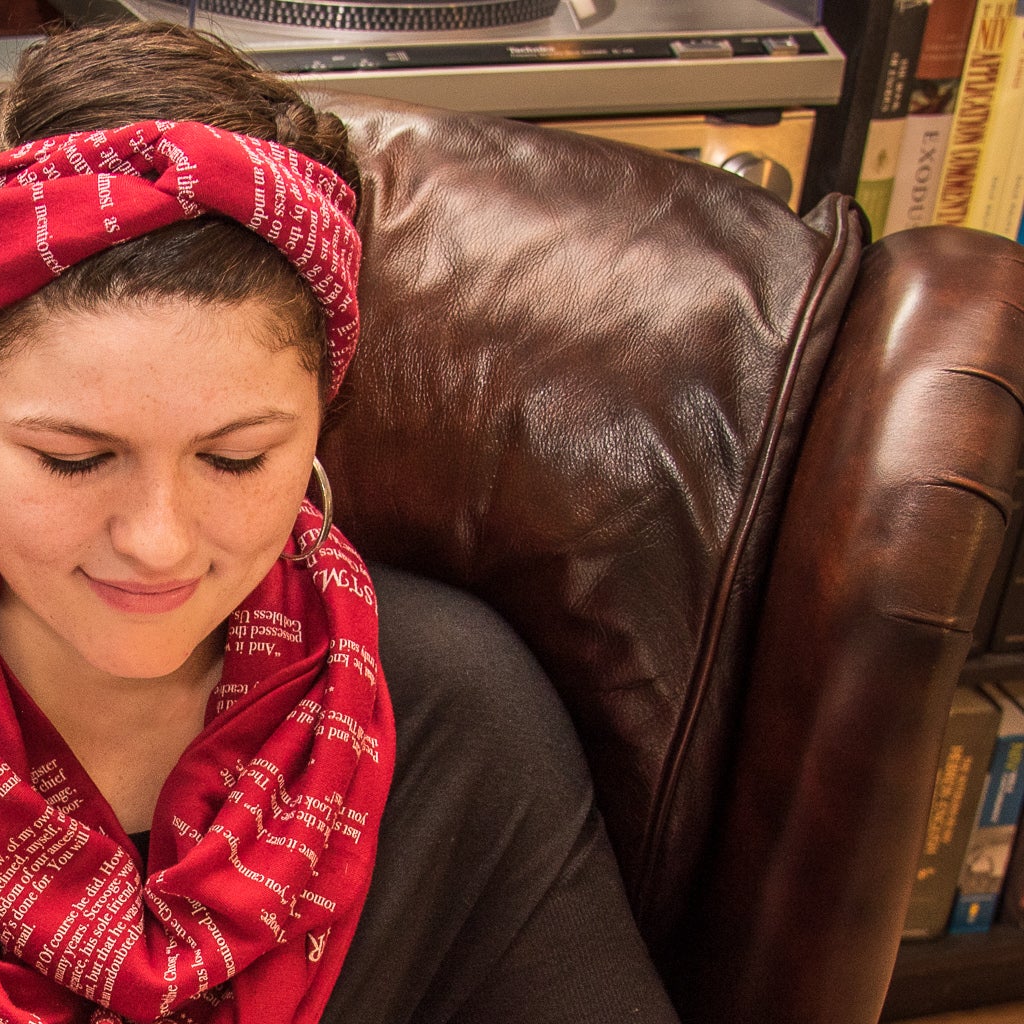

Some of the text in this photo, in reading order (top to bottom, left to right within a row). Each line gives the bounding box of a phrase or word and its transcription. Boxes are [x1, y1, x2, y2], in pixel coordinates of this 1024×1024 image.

[7, 838, 19, 852] of
[18, 826, 36, 842] my
[21, 866, 34, 884] of
[31, 852, 50, 872] our
[13, 891, 39, 921] done
[51, 911, 79, 948] course
[76, 896, 90, 913] he
[88, 876, 107, 898] did.
[83, 878, 122, 921] Scrooge
[79, 937, 98, 957] his
[97, 914, 113, 940] sole
[97, 933, 117, 963] that
[110, 921, 126, 940] he
